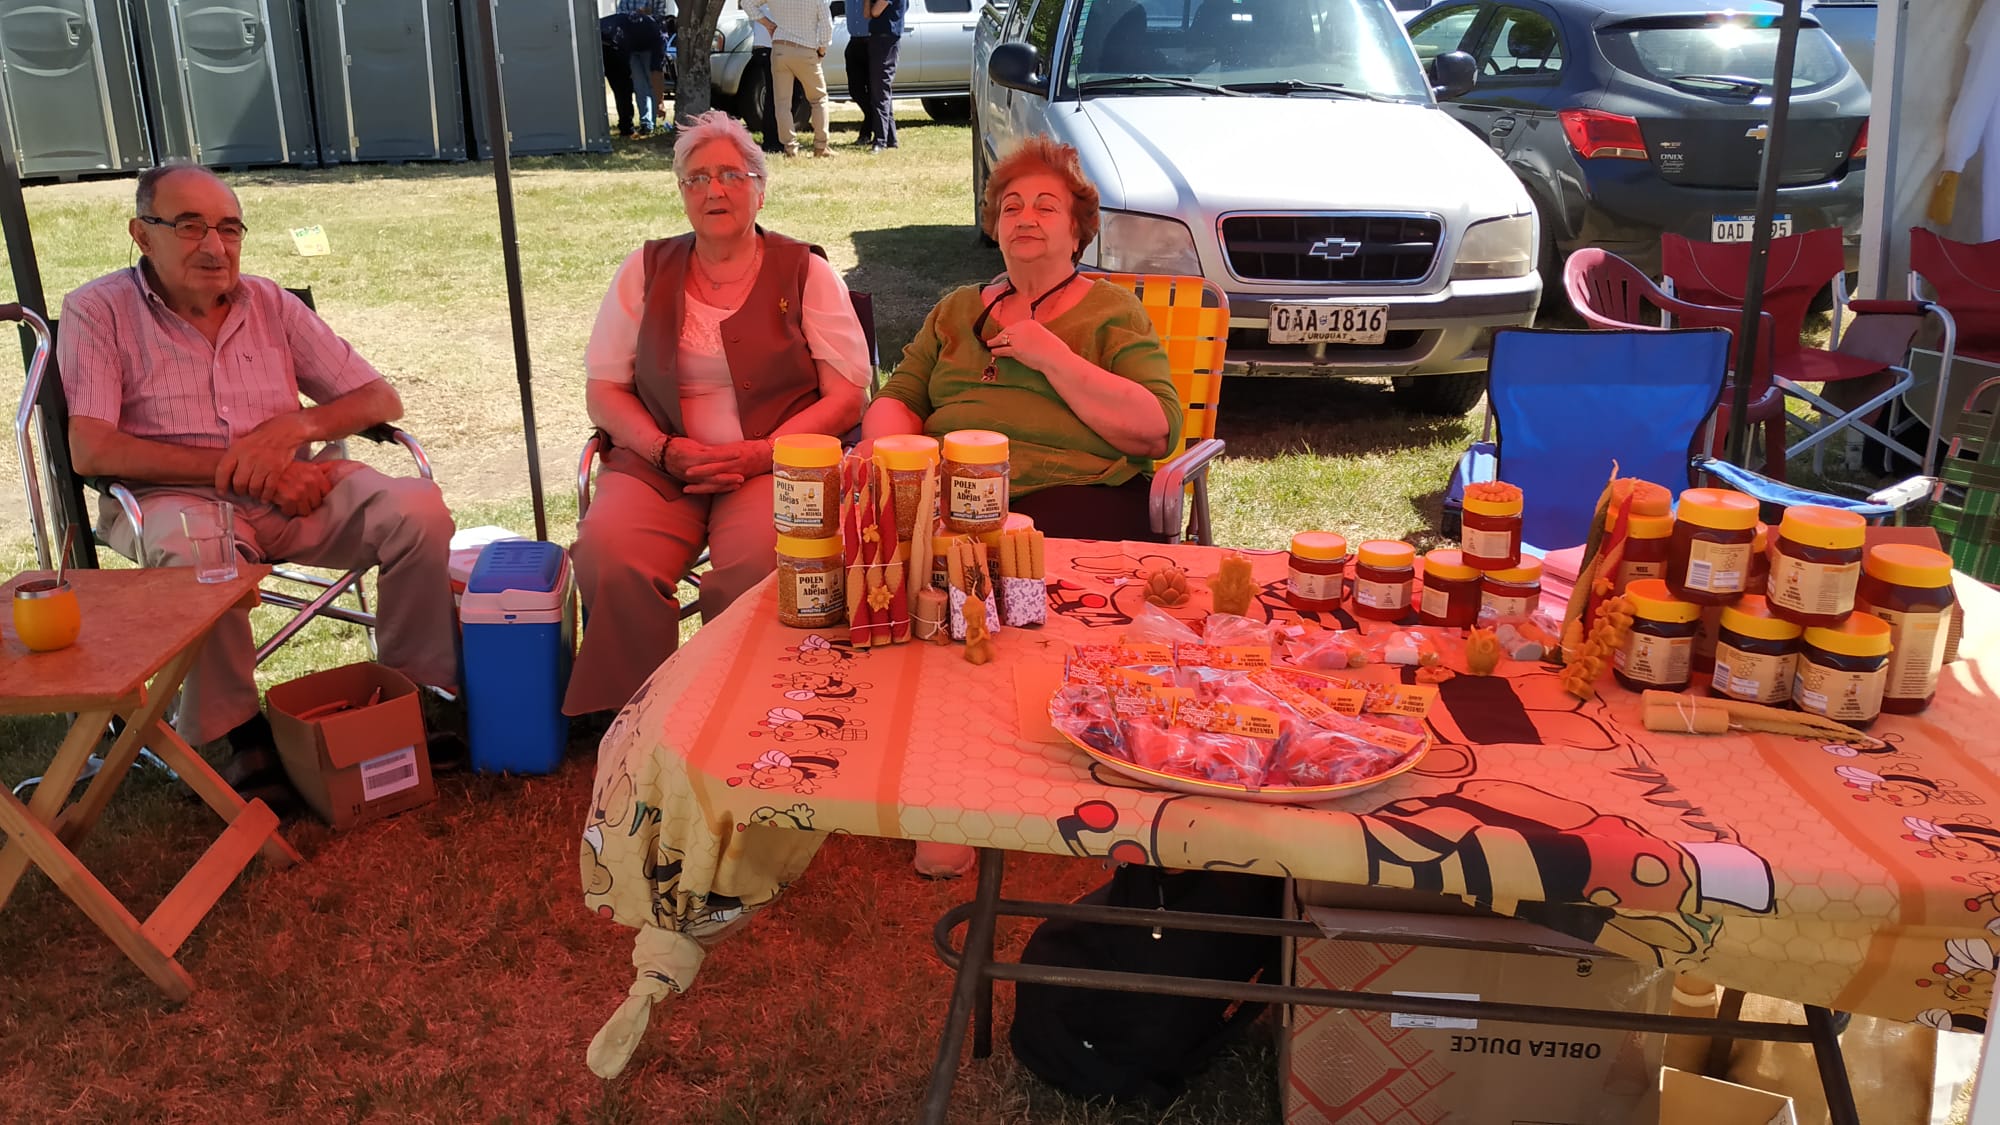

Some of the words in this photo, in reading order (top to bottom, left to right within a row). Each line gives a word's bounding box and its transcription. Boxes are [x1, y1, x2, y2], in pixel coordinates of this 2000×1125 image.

[1717, 223, 1745, 240] OAD
[1277, 308, 1318, 331] OAA
[1329, 309, 1382, 331] 1816
[1308, 332, 1348, 340] URUGUAY
[776, 481, 795, 491] POLEN
[954, 480, 977, 489] POLEN
[779, 494, 800, 505] Abejas
[957, 492, 981, 502] Abejas
[799, 576, 824, 584] POLEN
[803, 587, 828, 596] Abejas
[1450, 1035, 1522, 1056] DULCE
[1529, 1040, 1601, 1060] OBLEA
